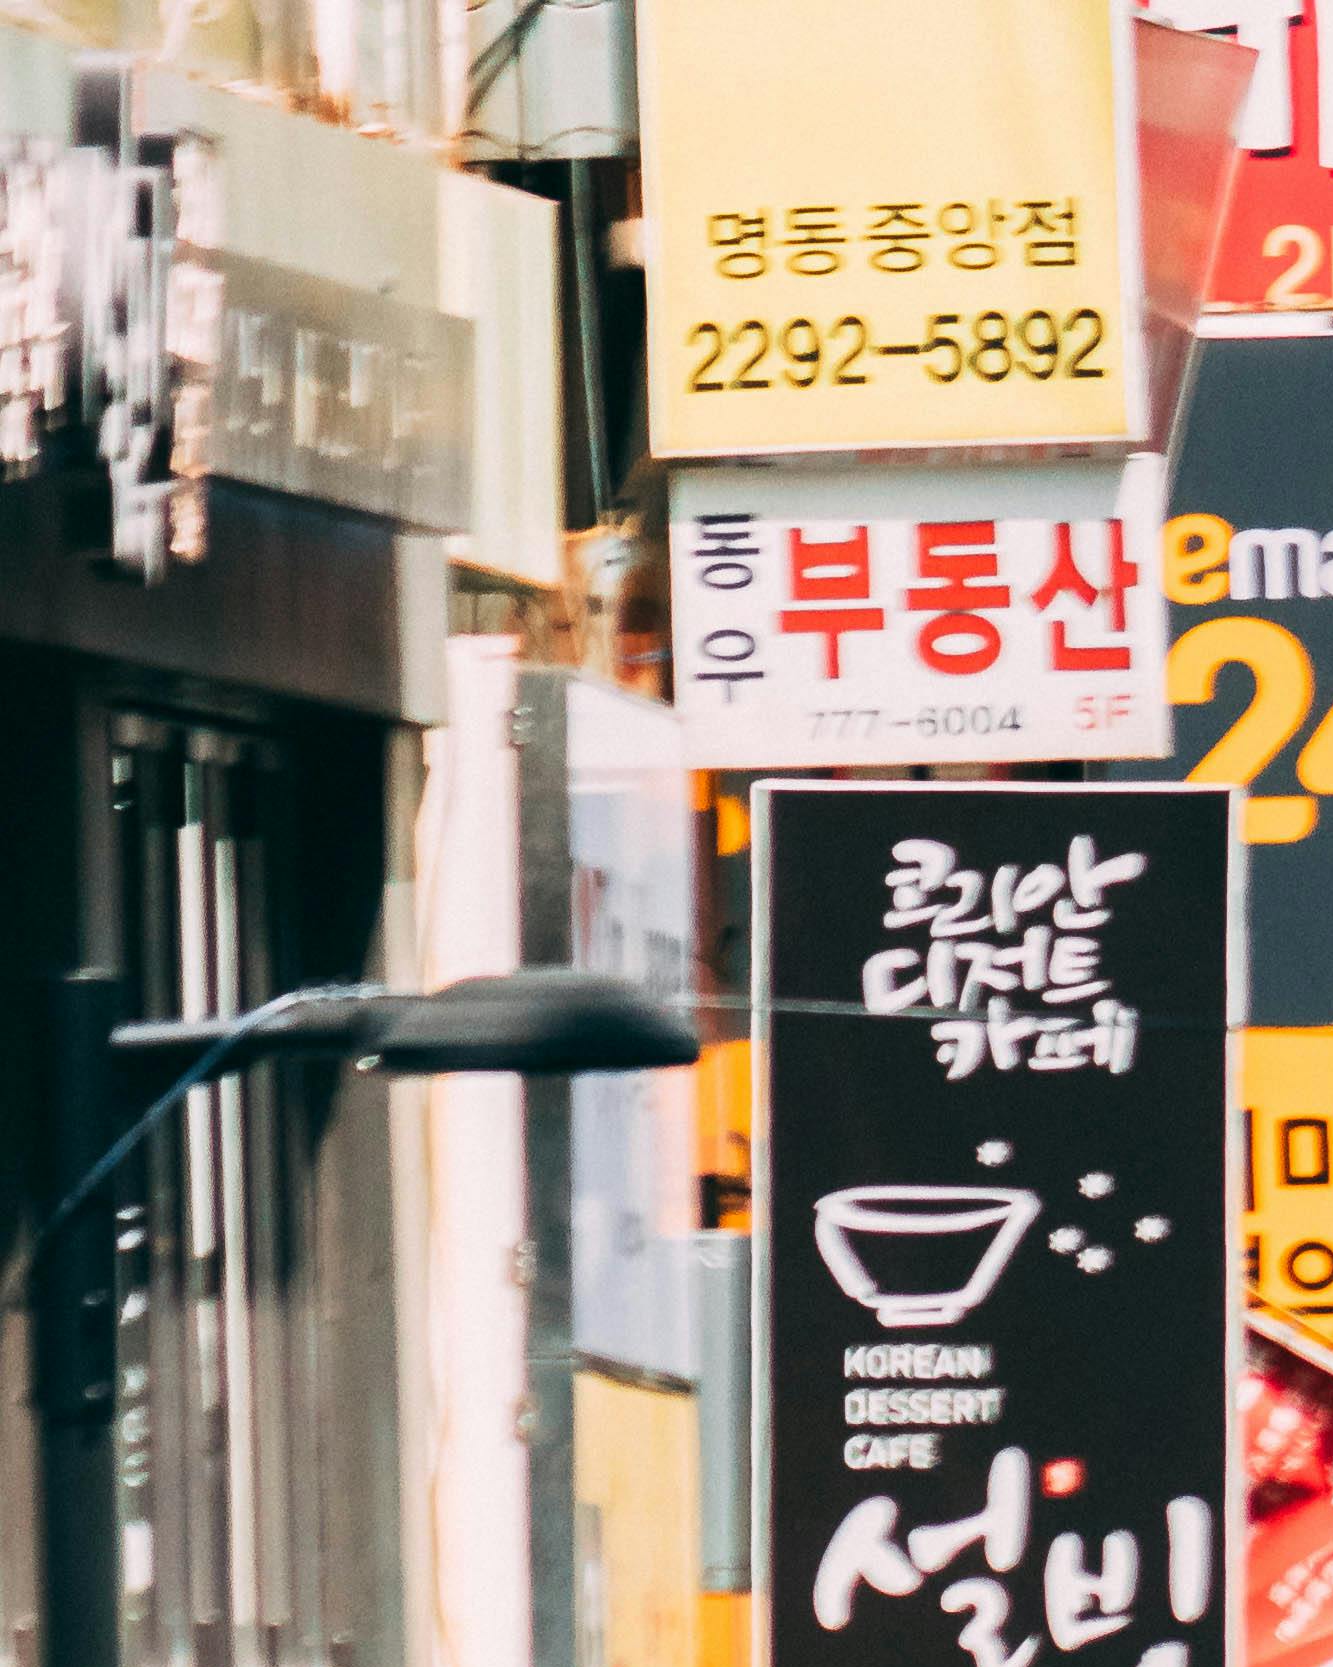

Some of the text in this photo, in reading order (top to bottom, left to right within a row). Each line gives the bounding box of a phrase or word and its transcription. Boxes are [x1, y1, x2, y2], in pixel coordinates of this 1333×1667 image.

[706, 204, 1077, 279] 명동중앙점
[685, 309, 1108, 394] 2292-5892
[692, 513, 766, 703] 동우
[778, 519, 1139, 677] 부동산
[843, 1344, 992, 1380] KOREAN
[843, 1388, 1005, 1426] DESSERT
[843, 1433, 941, 1470] CAFE
